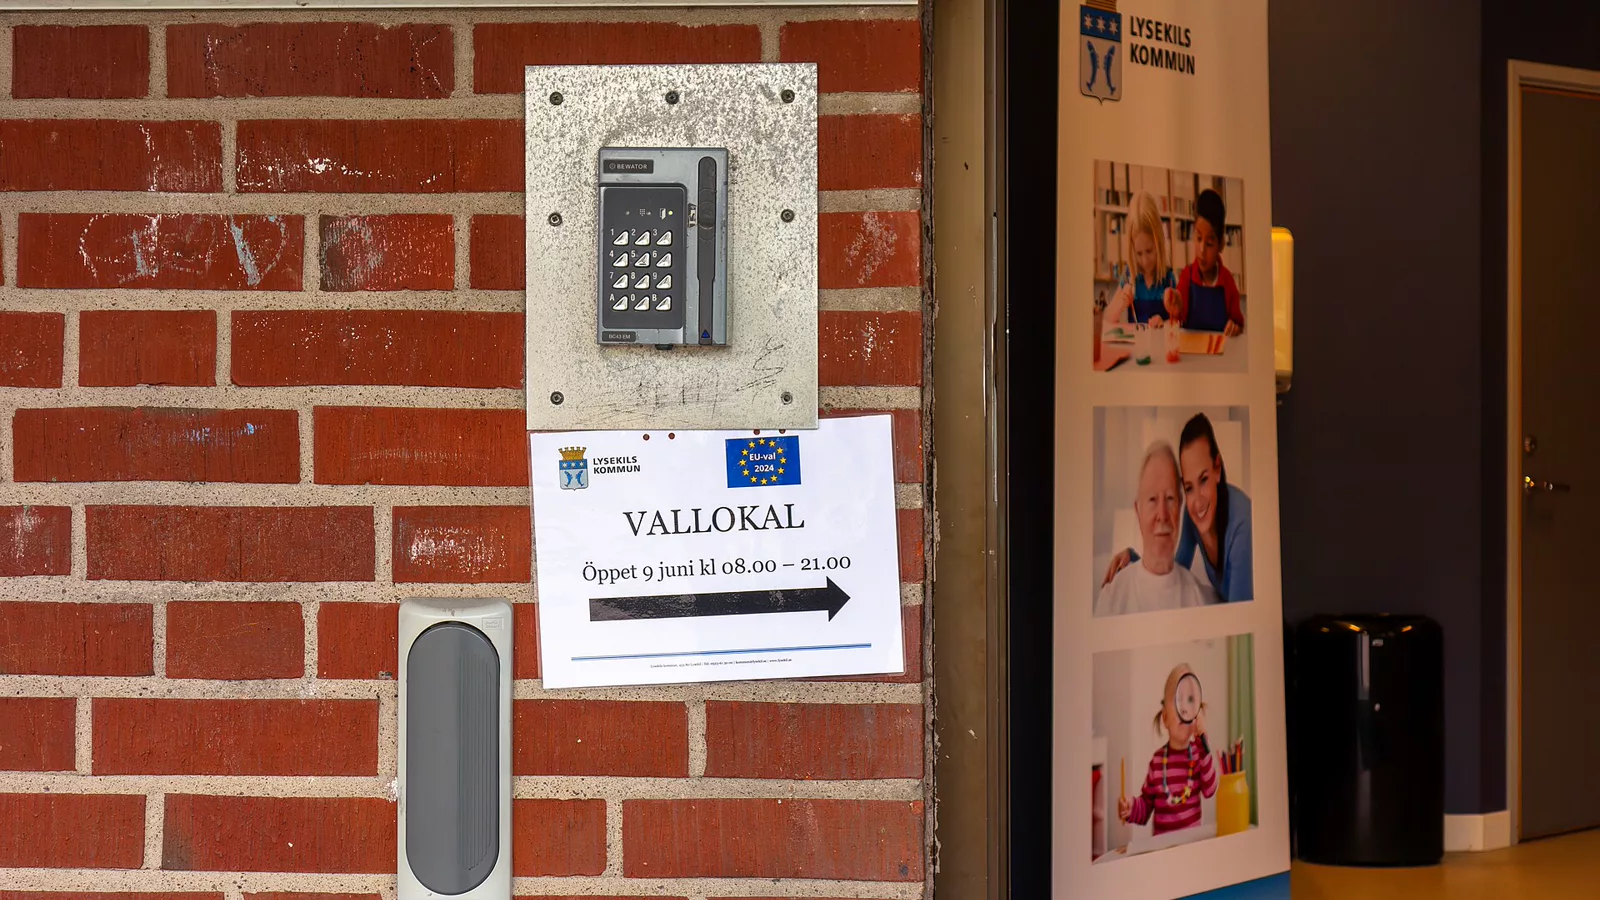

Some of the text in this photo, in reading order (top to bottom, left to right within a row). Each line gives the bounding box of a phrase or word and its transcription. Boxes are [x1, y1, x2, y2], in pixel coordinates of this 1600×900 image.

[1130, 15, 1191, 48] LYSEKILS
[1130, 42, 1195, 75] KOMMUN
[610, 228, 658, 236] 1 2 3
[609, 271, 658, 279] 7 8 9
[609, 293, 615, 301] A
[652, 293, 657, 301] B
[593, 455, 638, 466] LYSEKILS
[749, 452, 776, 461] EU-val
[593, 464, 641, 475] KOMMUN
[754, 464, 775, 473] 2024
[623, 503, 805, 536] VALLOKAL
[582, 561, 638, 585] Öppet
[642, 565, 653, 582] 9
[657, 560, 694, 582] juni
[699, 559, 717, 576] kl
[722, 558, 777, 575] 08.00
[800, 556, 851, 571] 21.00
